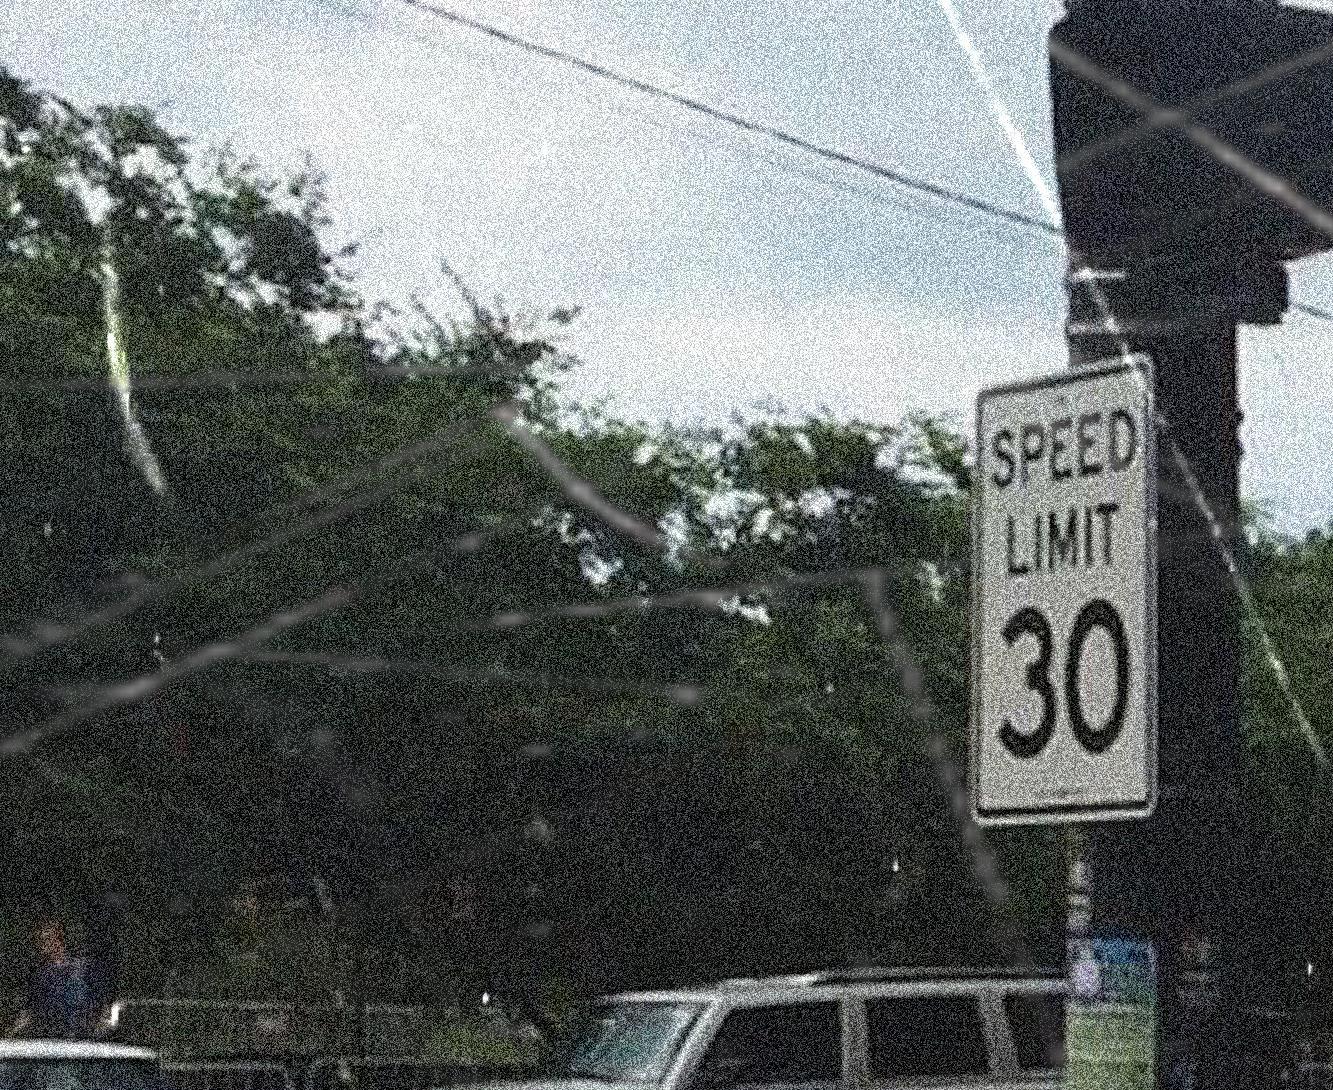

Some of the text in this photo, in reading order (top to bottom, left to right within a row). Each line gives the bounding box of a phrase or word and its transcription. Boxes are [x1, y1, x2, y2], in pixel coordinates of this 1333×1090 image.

[990, 409, 1136, 488] SPEED
[1007, 503, 1119, 575] LIMIT
[998, 599, 1129, 759] 30
